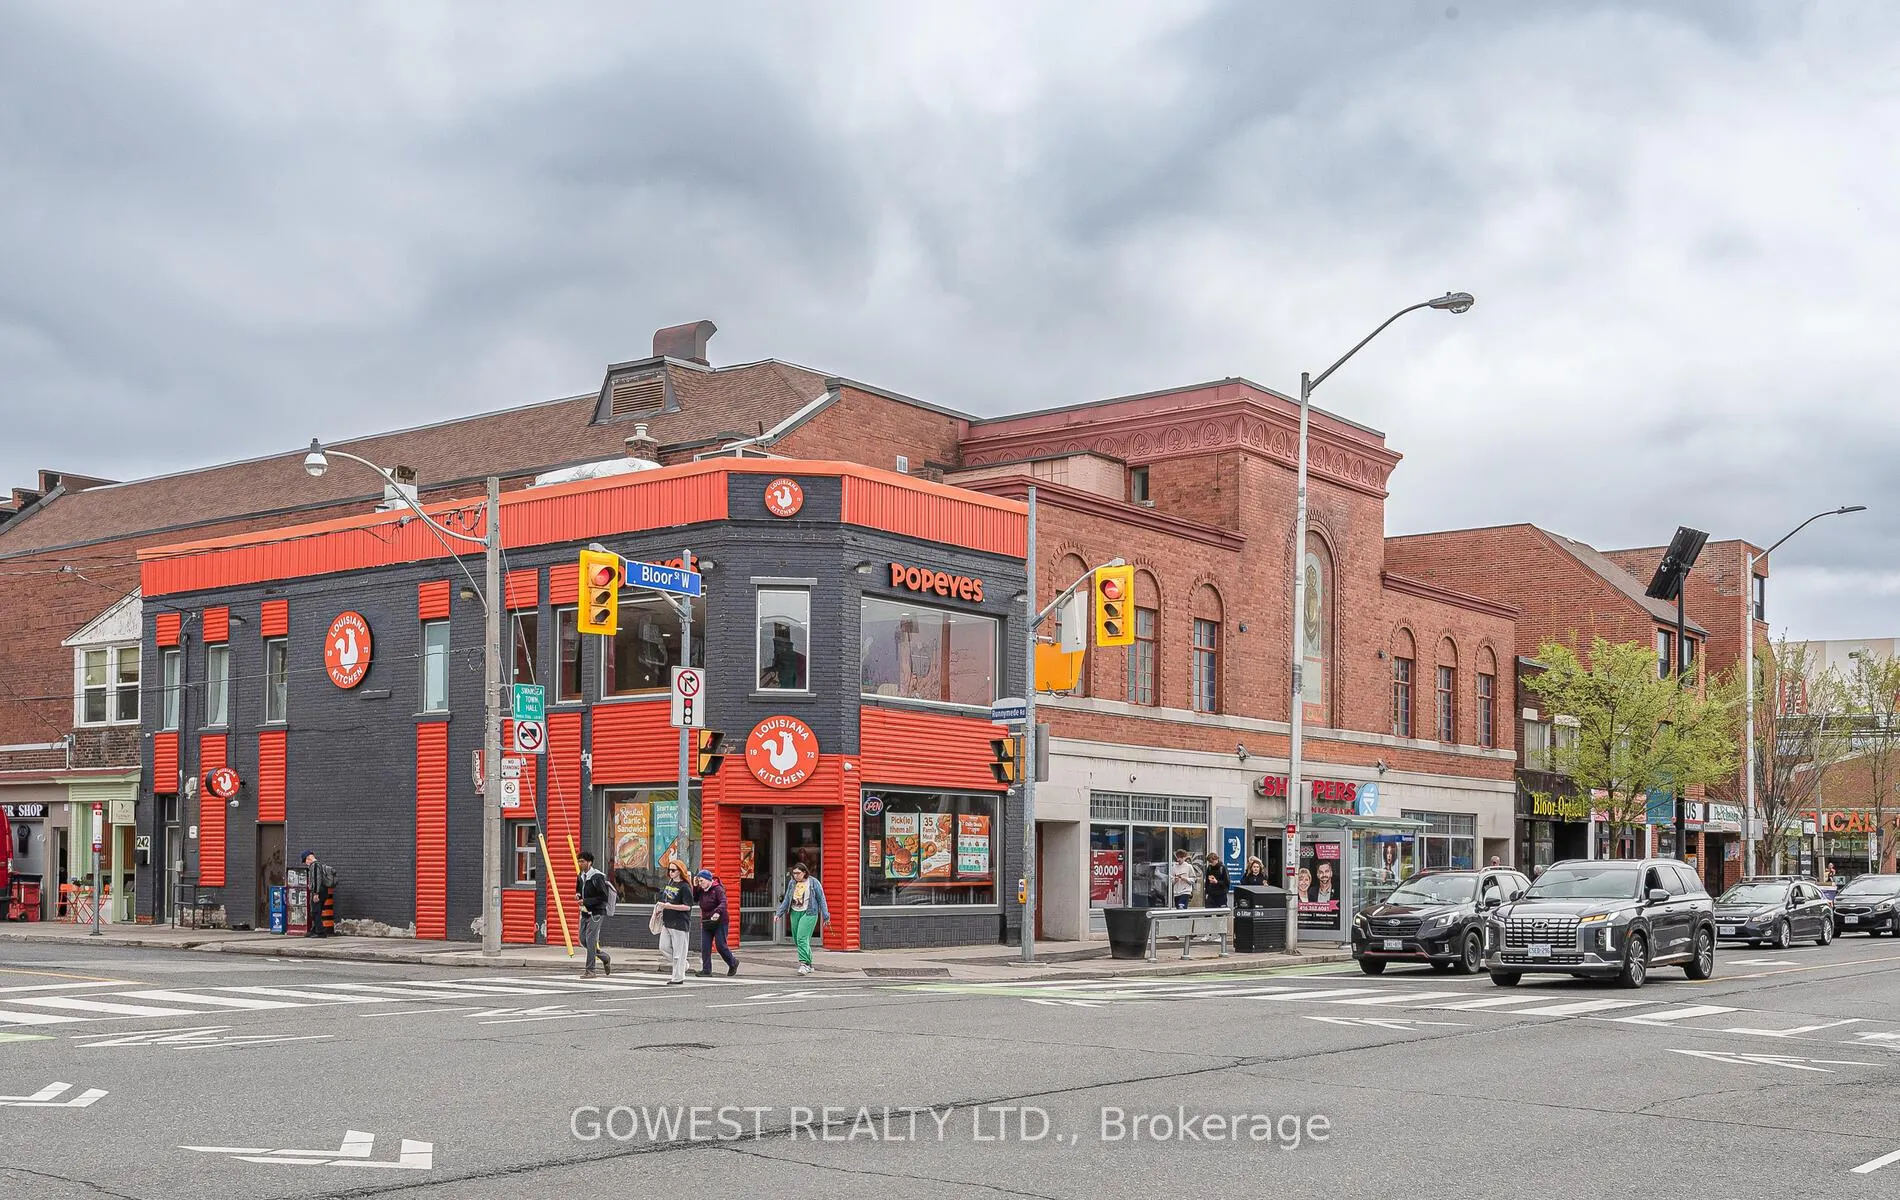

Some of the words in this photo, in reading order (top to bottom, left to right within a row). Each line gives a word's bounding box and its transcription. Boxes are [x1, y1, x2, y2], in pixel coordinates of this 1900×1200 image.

[770, 480, 799, 492] LOUISIANA
[641, 566, 673, 585] Bloor
[674, 571, 680, 580] St
[681, 573, 690, 588] W
[330, 616, 366, 639] LOUISIANA
[331, 666, 363, 685] KITCHEN
[755, 719, 809, 741] LOUISIANA
[806, 751, 815, 759] 72
[757, 767, 806, 785] KITCHEN
[1263, 776, 1357, 802] SHPERS
[18, 804, 43, 817] SHOP
[864, 801, 882, 811] OPEN
[1533, 793, 1556, 816] Bloor
[617, 825, 647, 833] Sandwich
[924, 817, 934, 827] 35
[136, 836, 149, 848] 242
